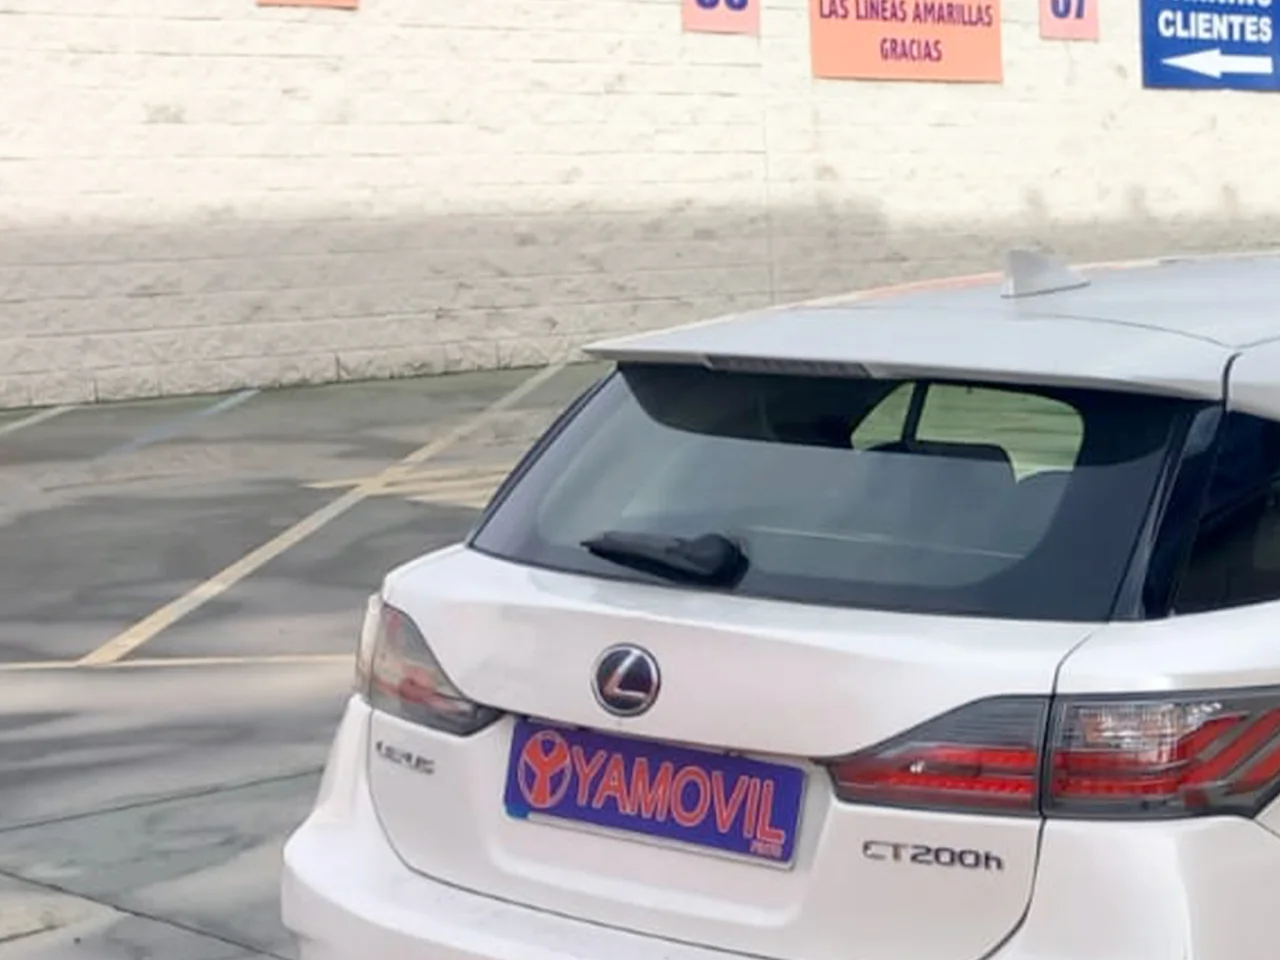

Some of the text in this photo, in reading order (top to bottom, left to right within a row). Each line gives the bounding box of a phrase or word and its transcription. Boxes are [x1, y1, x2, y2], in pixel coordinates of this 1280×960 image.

[819, 0, 849, 19] LAS
[912, 3, 993, 28] AMARILLAS
[1157, 8, 1273, 44] CLIENTES
[879, 37, 943, 62] GRACIAS
[571, 745, 786, 844] YAMOVIL
[862, 840, 1004, 871] CT200h
